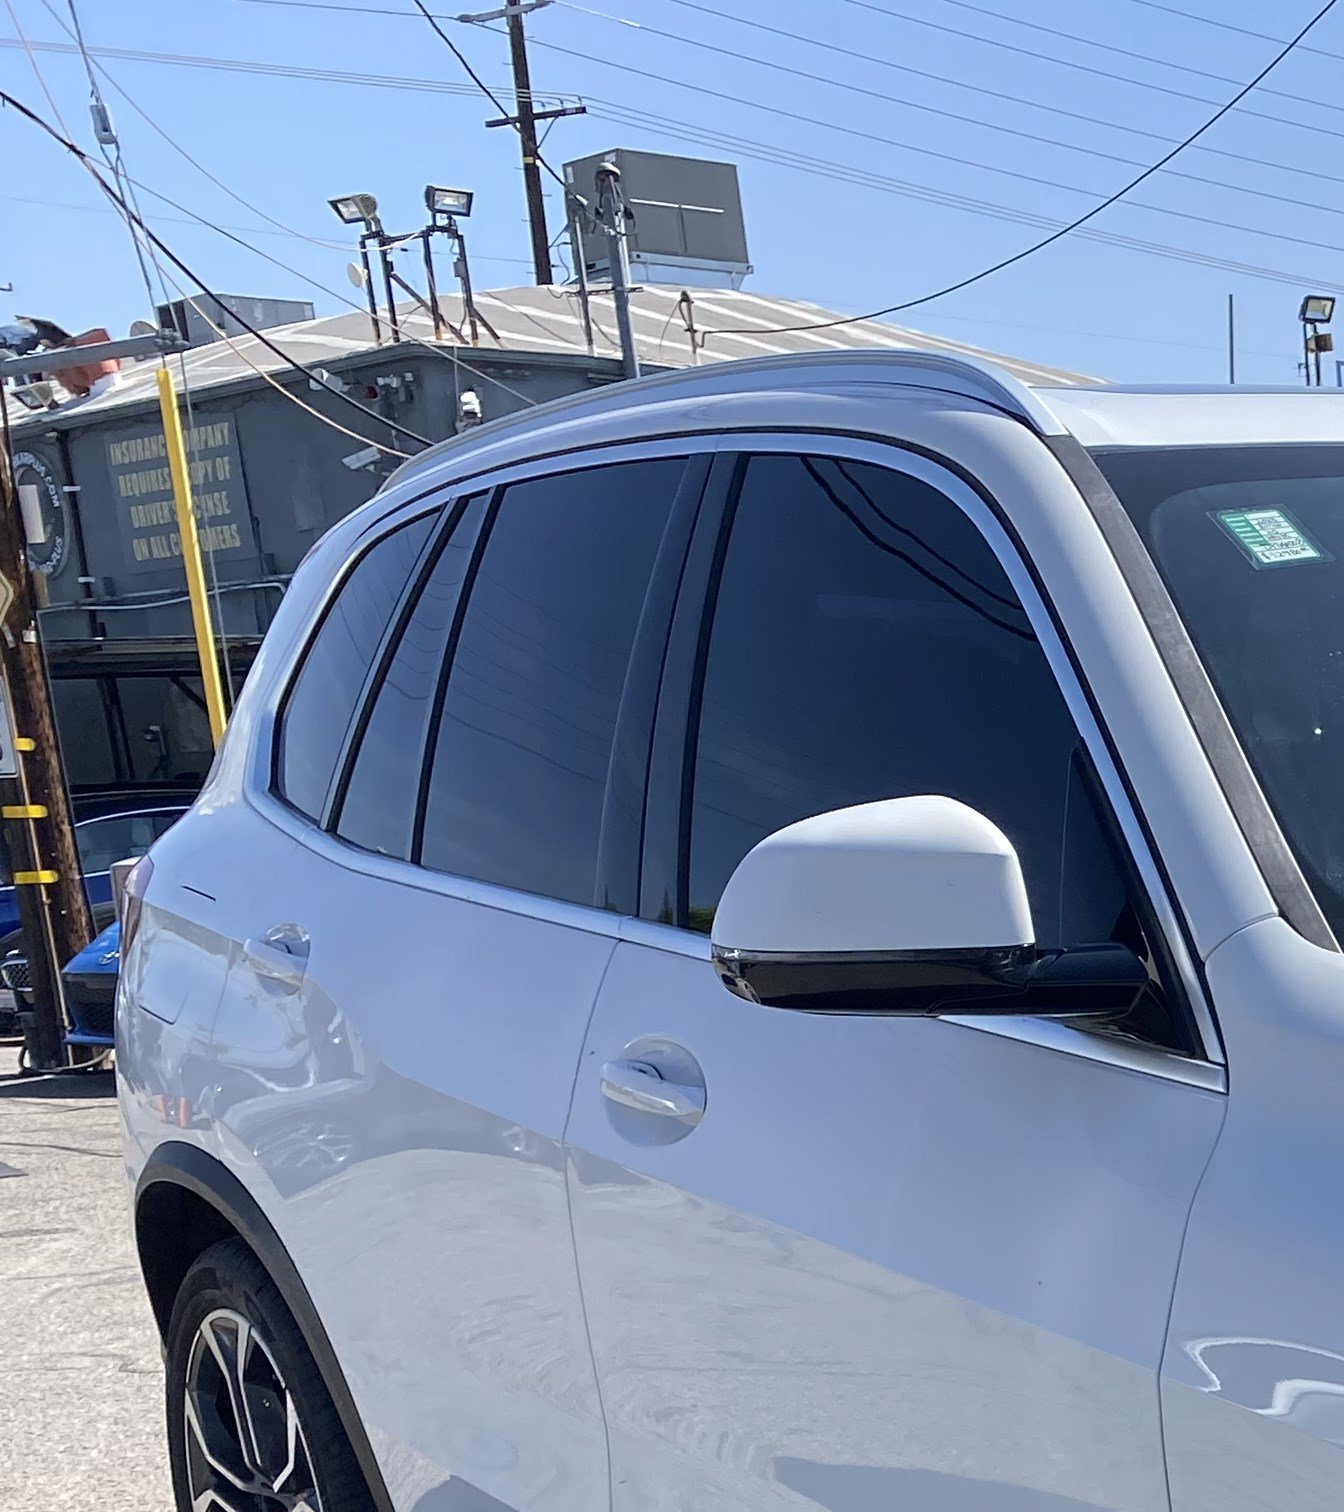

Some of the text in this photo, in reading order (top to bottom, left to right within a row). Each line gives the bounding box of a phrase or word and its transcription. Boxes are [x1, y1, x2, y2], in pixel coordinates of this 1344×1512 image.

[109, 422, 230, 466] INSURANC OMPANY
[193, 491, 231, 519] CENSE
